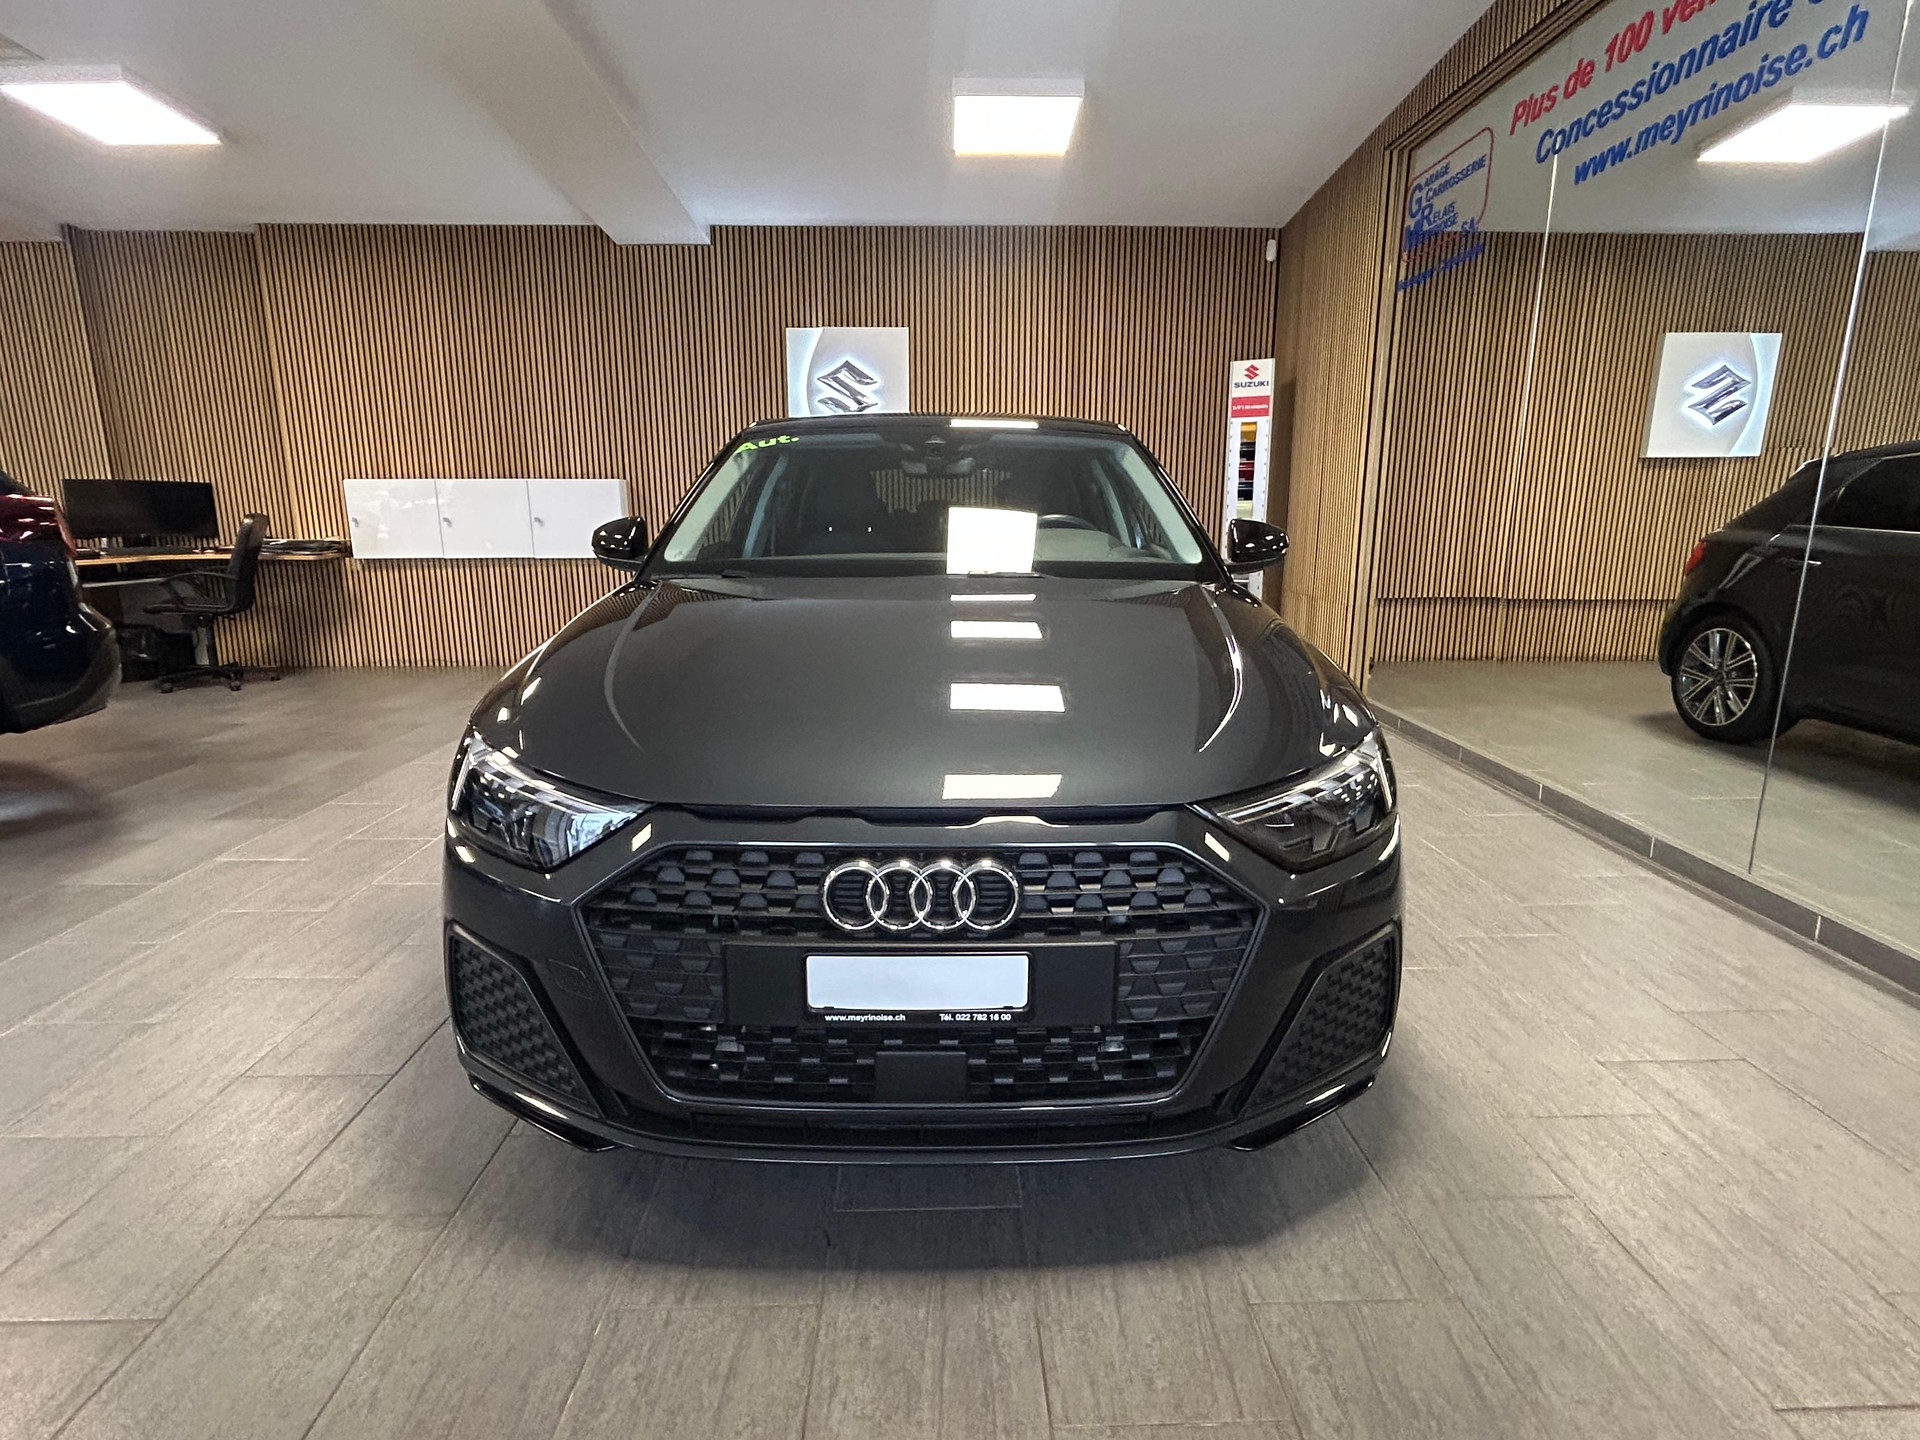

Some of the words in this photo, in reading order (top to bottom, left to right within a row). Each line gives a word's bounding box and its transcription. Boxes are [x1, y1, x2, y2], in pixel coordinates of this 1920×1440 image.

[1509, 83, 1558, 136] Plus
[1563, 56, 1595, 101] de
[1604, 11, 1655, 74] 100
[1535, 0, 1792, 164] Concessionnaire
[1573, 4, 1870, 186] www.meyrinoise.ch
[1425, 153, 1487, 203] CARROSSERIE
[735, 434, 800, 454] Aut.
[824, 1013, 906, 1023] www.meyrinoise.ch
